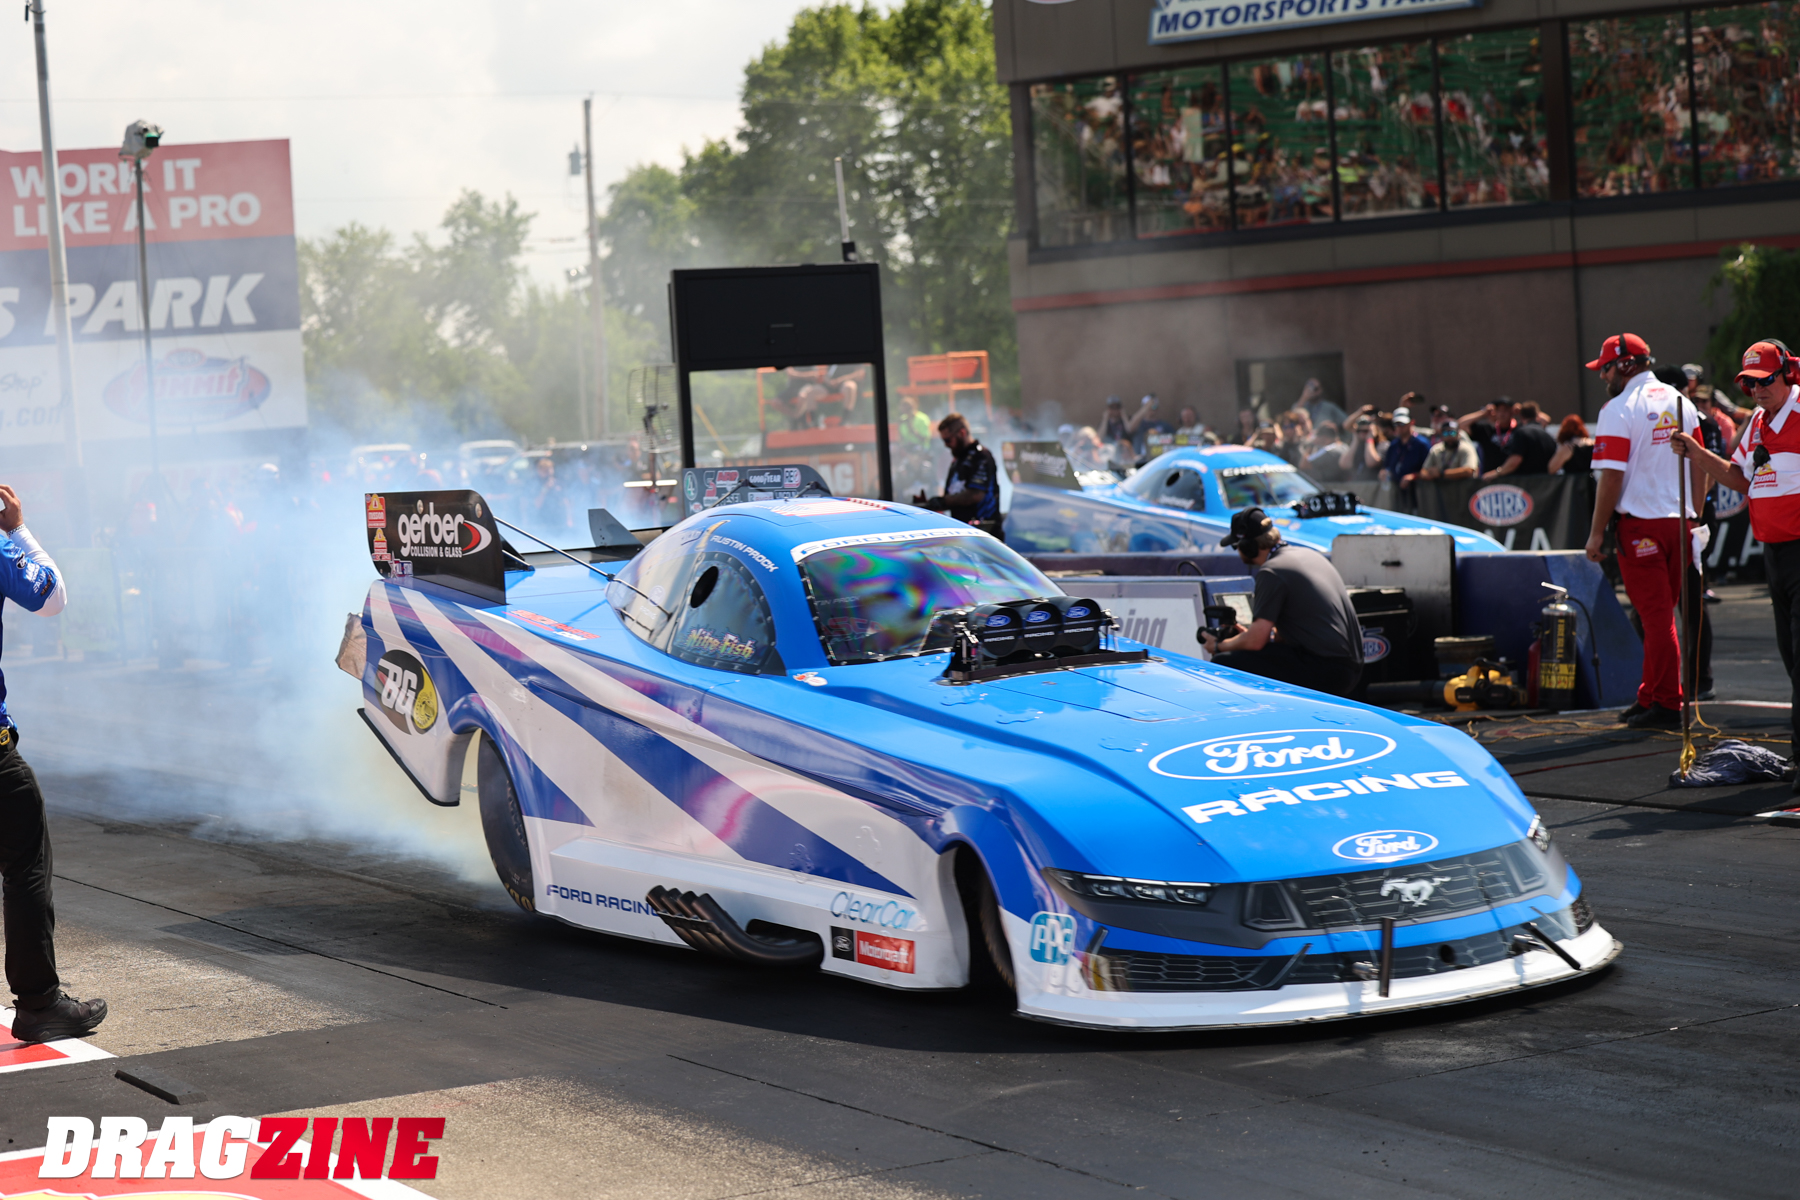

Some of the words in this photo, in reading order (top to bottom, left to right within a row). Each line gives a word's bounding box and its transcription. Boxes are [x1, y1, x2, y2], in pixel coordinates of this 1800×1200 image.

[10, 160, 151, 198] WORK
[163, 158, 202, 192] IT
[13, 201, 111, 237] LIKE
[123, 199, 157, 233] A
[169, 192, 262, 230] PRO
[43, 272, 266, 337] PARK
[749, 471, 782, 485] GOODYEAR
[1717, 482, 1745, 511] RA
[1479, 491, 1526, 518] NHRA
[397, 502, 465, 557] gerber
[801, 536, 882, 555] FORD
[410, 546, 438, 557] COLLISION
[439, 547, 445, 557] &
[444, 547, 463, 558] GLASS
[710, 535, 747, 551] AUSTIN
[742, 546, 779, 572] PROCK
[378, 658, 418, 716] BG
[1203, 735, 1355, 774] Ford
[1181, 770, 1471, 824] RACING
[1355, 834, 1422, 858] Ford
[546, 884, 592, 905] FORD
[830, 892, 916, 929] ClearCar
[859, 939, 909, 964] Motorcraft
[1032, 918, 1074, 961] PPG
